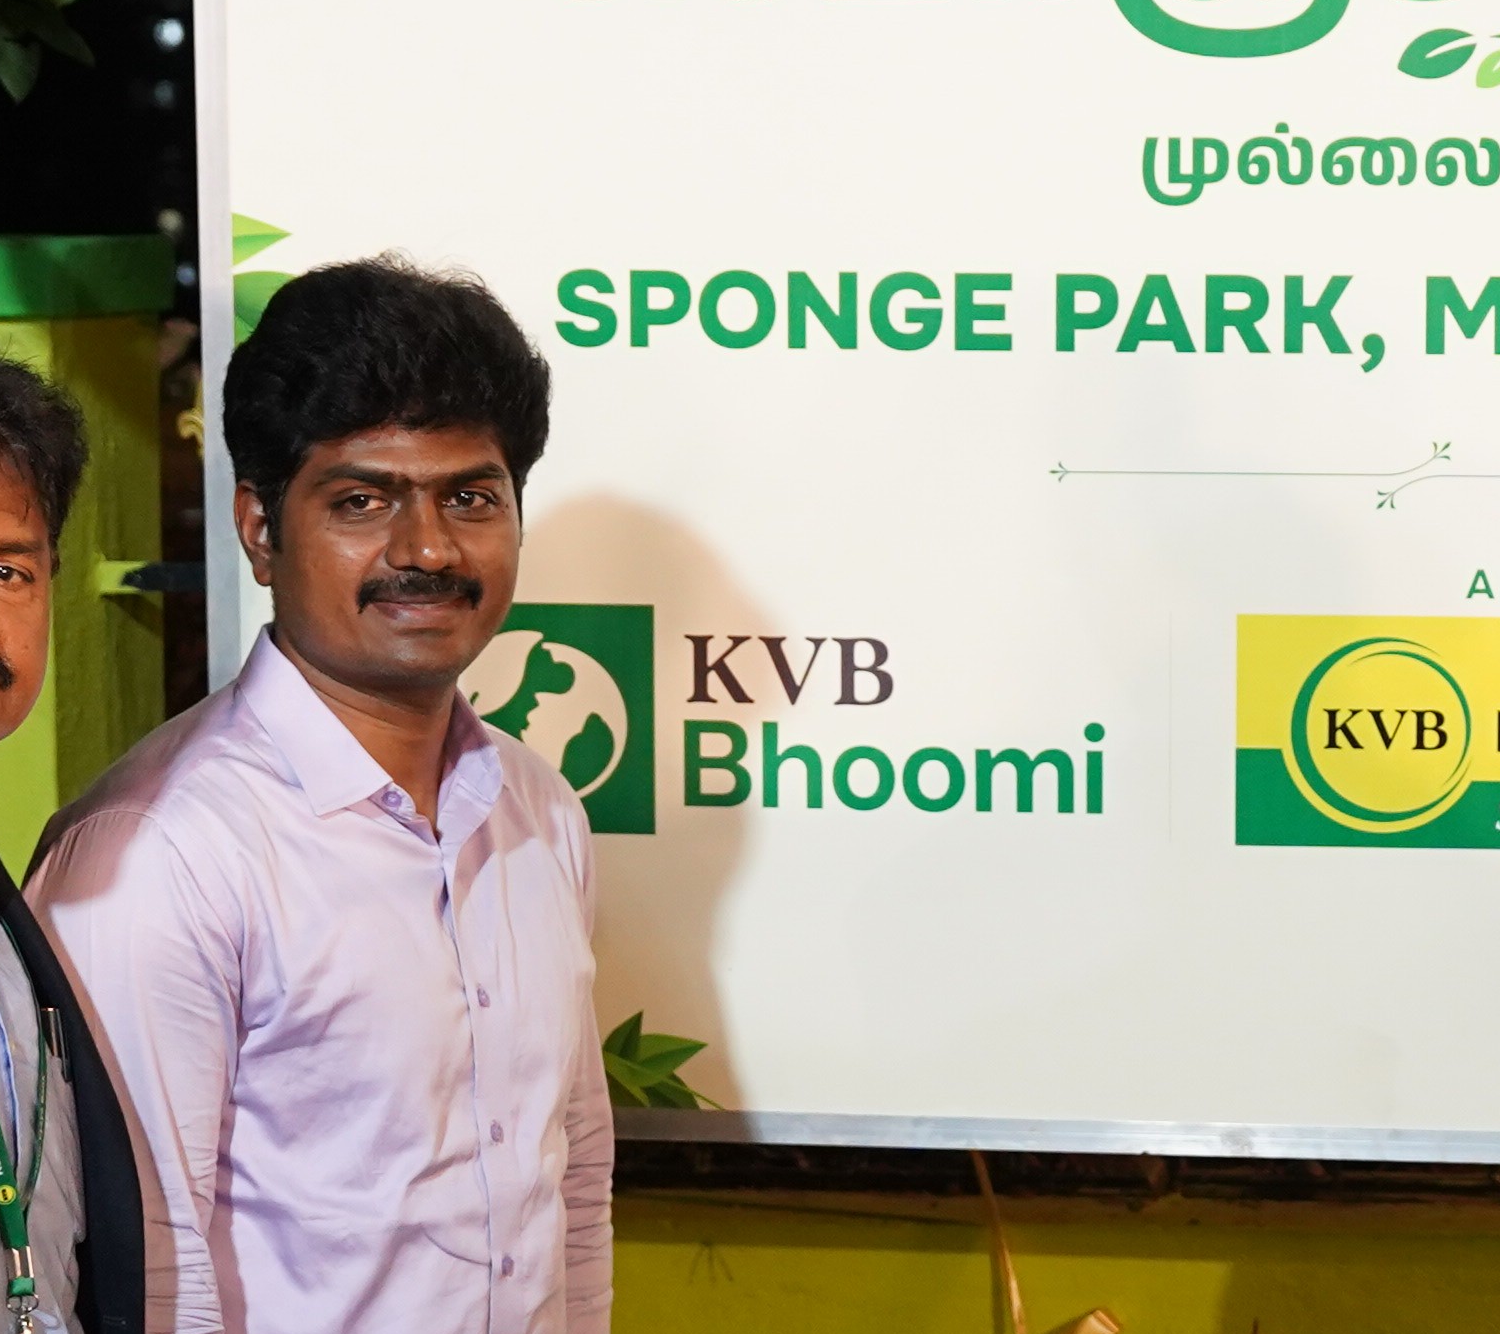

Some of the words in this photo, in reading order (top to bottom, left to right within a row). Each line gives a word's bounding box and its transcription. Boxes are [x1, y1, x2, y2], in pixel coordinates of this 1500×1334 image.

[556, 270, 1013, 353] SPONGE
[1057, 275, 1385, 373] PARK,
[1467, 571, 1495, 600] A
[684, 634, 894, 706] KVB
[1323, 707, 1449, 753] KVB
[683, 719, 1106, 815] Bhoomi
